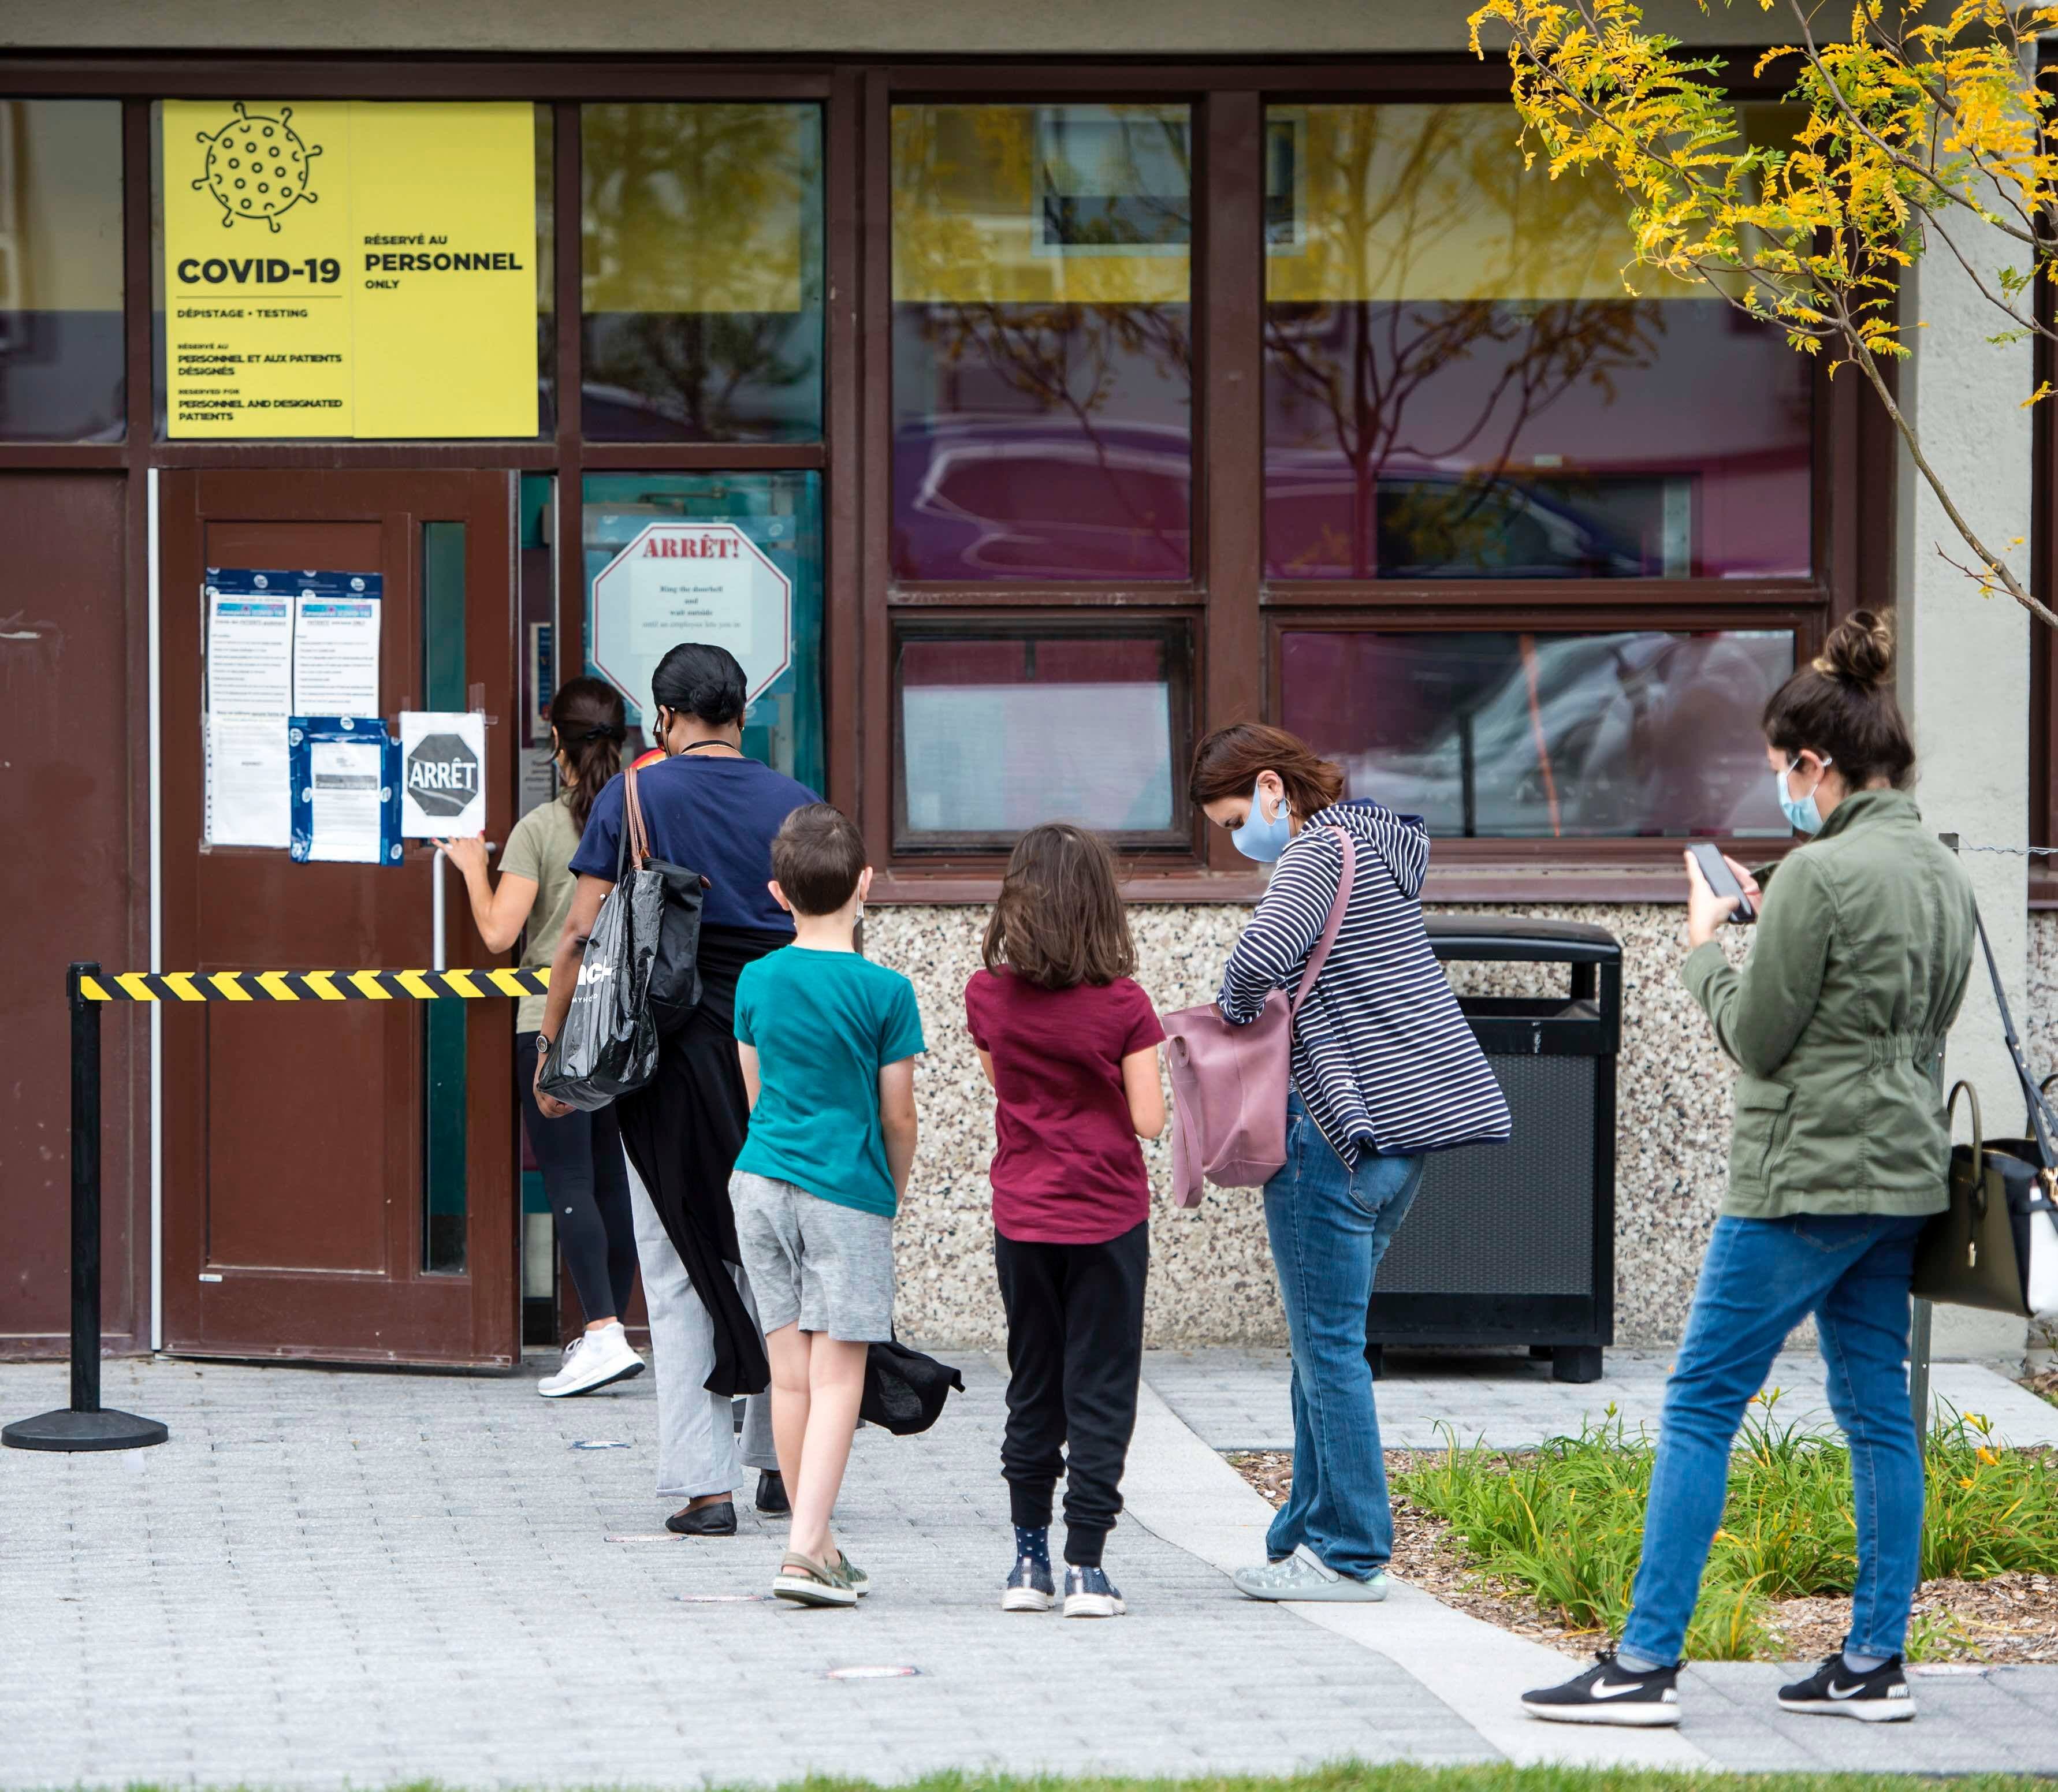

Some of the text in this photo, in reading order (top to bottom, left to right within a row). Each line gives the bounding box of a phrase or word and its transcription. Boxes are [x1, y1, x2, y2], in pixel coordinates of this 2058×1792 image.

[364, 235, 448, 245] RÉSERVÉ AU
[365, 253, 523, 271] PERSONNEL
[177, 259, 341, 284] COVID-19
[365, 280, 400, 290] ONLY
[177, 307, 308, 318] DÉPISTAGE TESTING
[178, 354, 342, 363] PERSONNEL ET AUX PATIENTS
[178, 366, 235, 375] DÉSIGNÉS
[178, 400, 343, 408] PERSONNEL AND DESIGNATED
[178, 412, 234, 420] PATIENTS
[642, 533, 739, 558] ARRÊT!
[409, 757, 477, 789] ARRÊT
